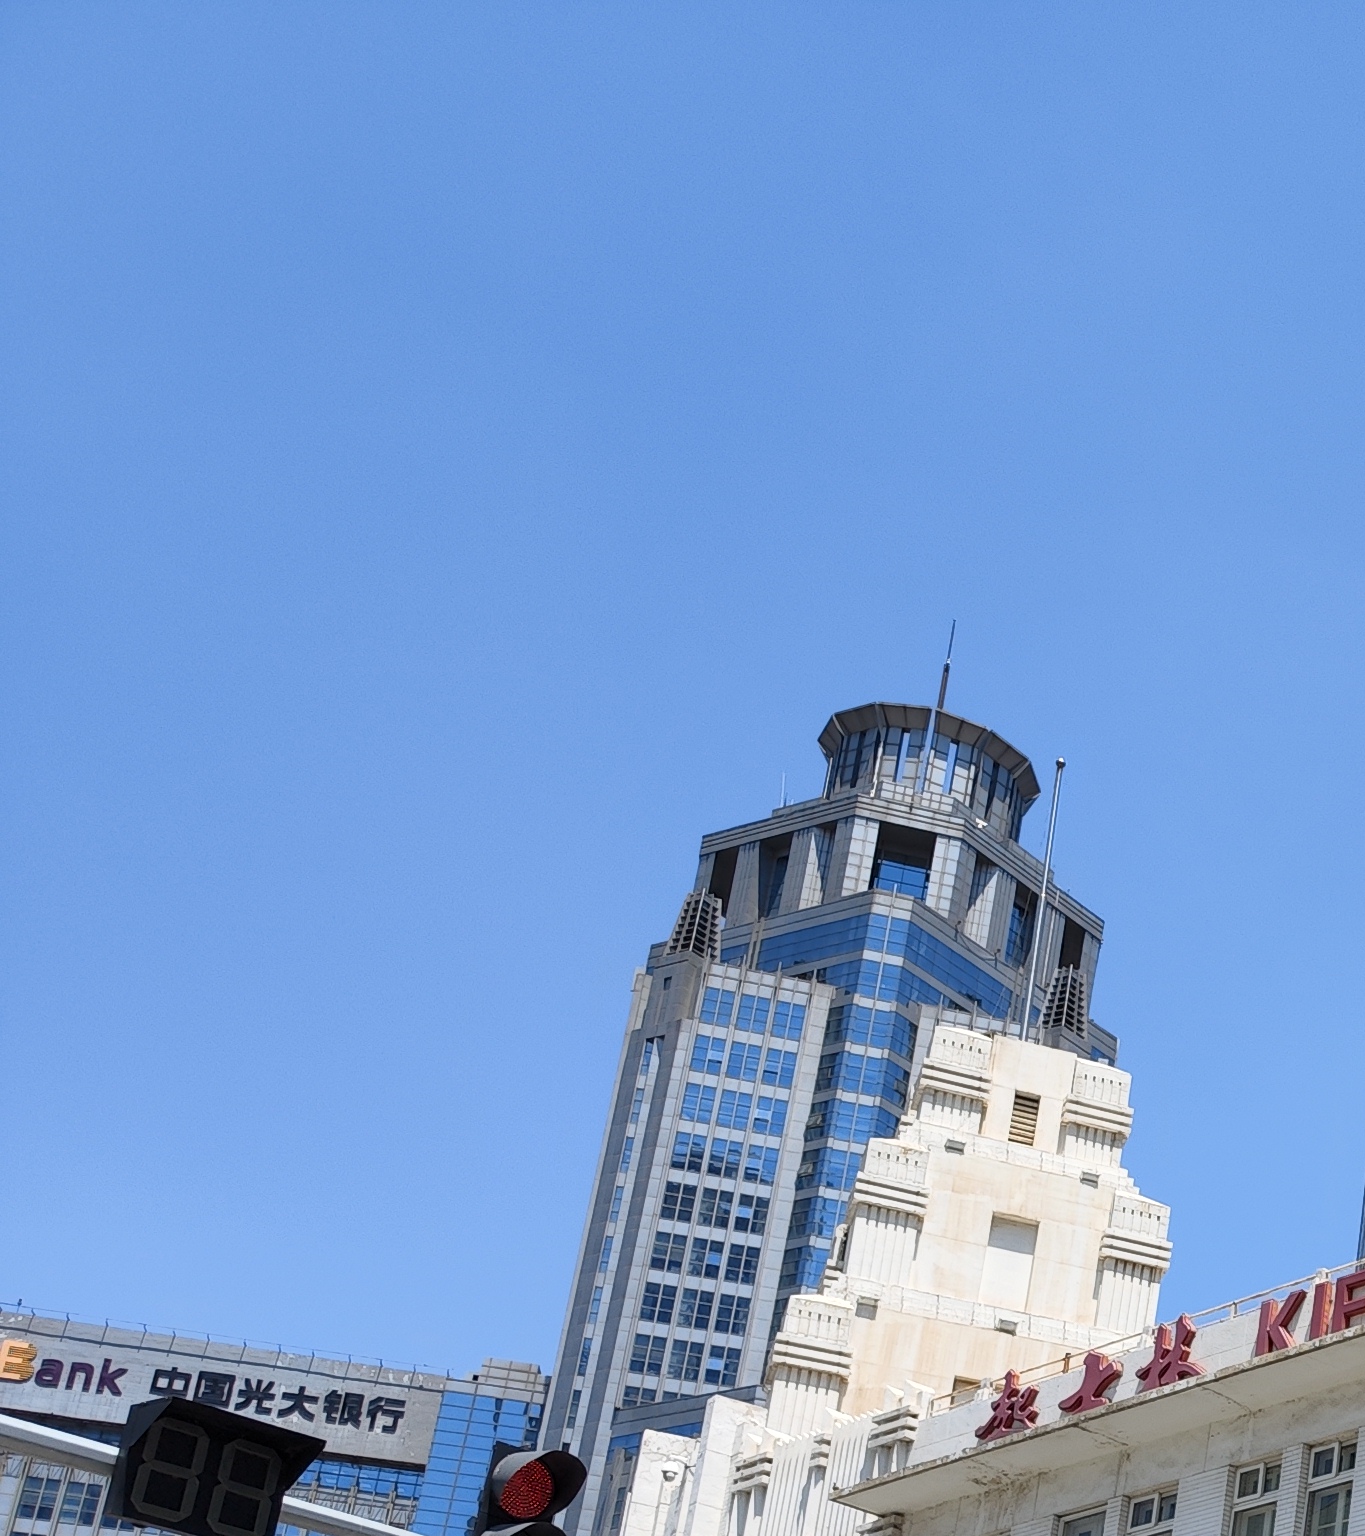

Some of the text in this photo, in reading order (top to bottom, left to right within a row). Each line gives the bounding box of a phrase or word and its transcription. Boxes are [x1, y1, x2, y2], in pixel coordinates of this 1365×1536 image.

[149, 1366, 407, 1435] 中国光大银行
